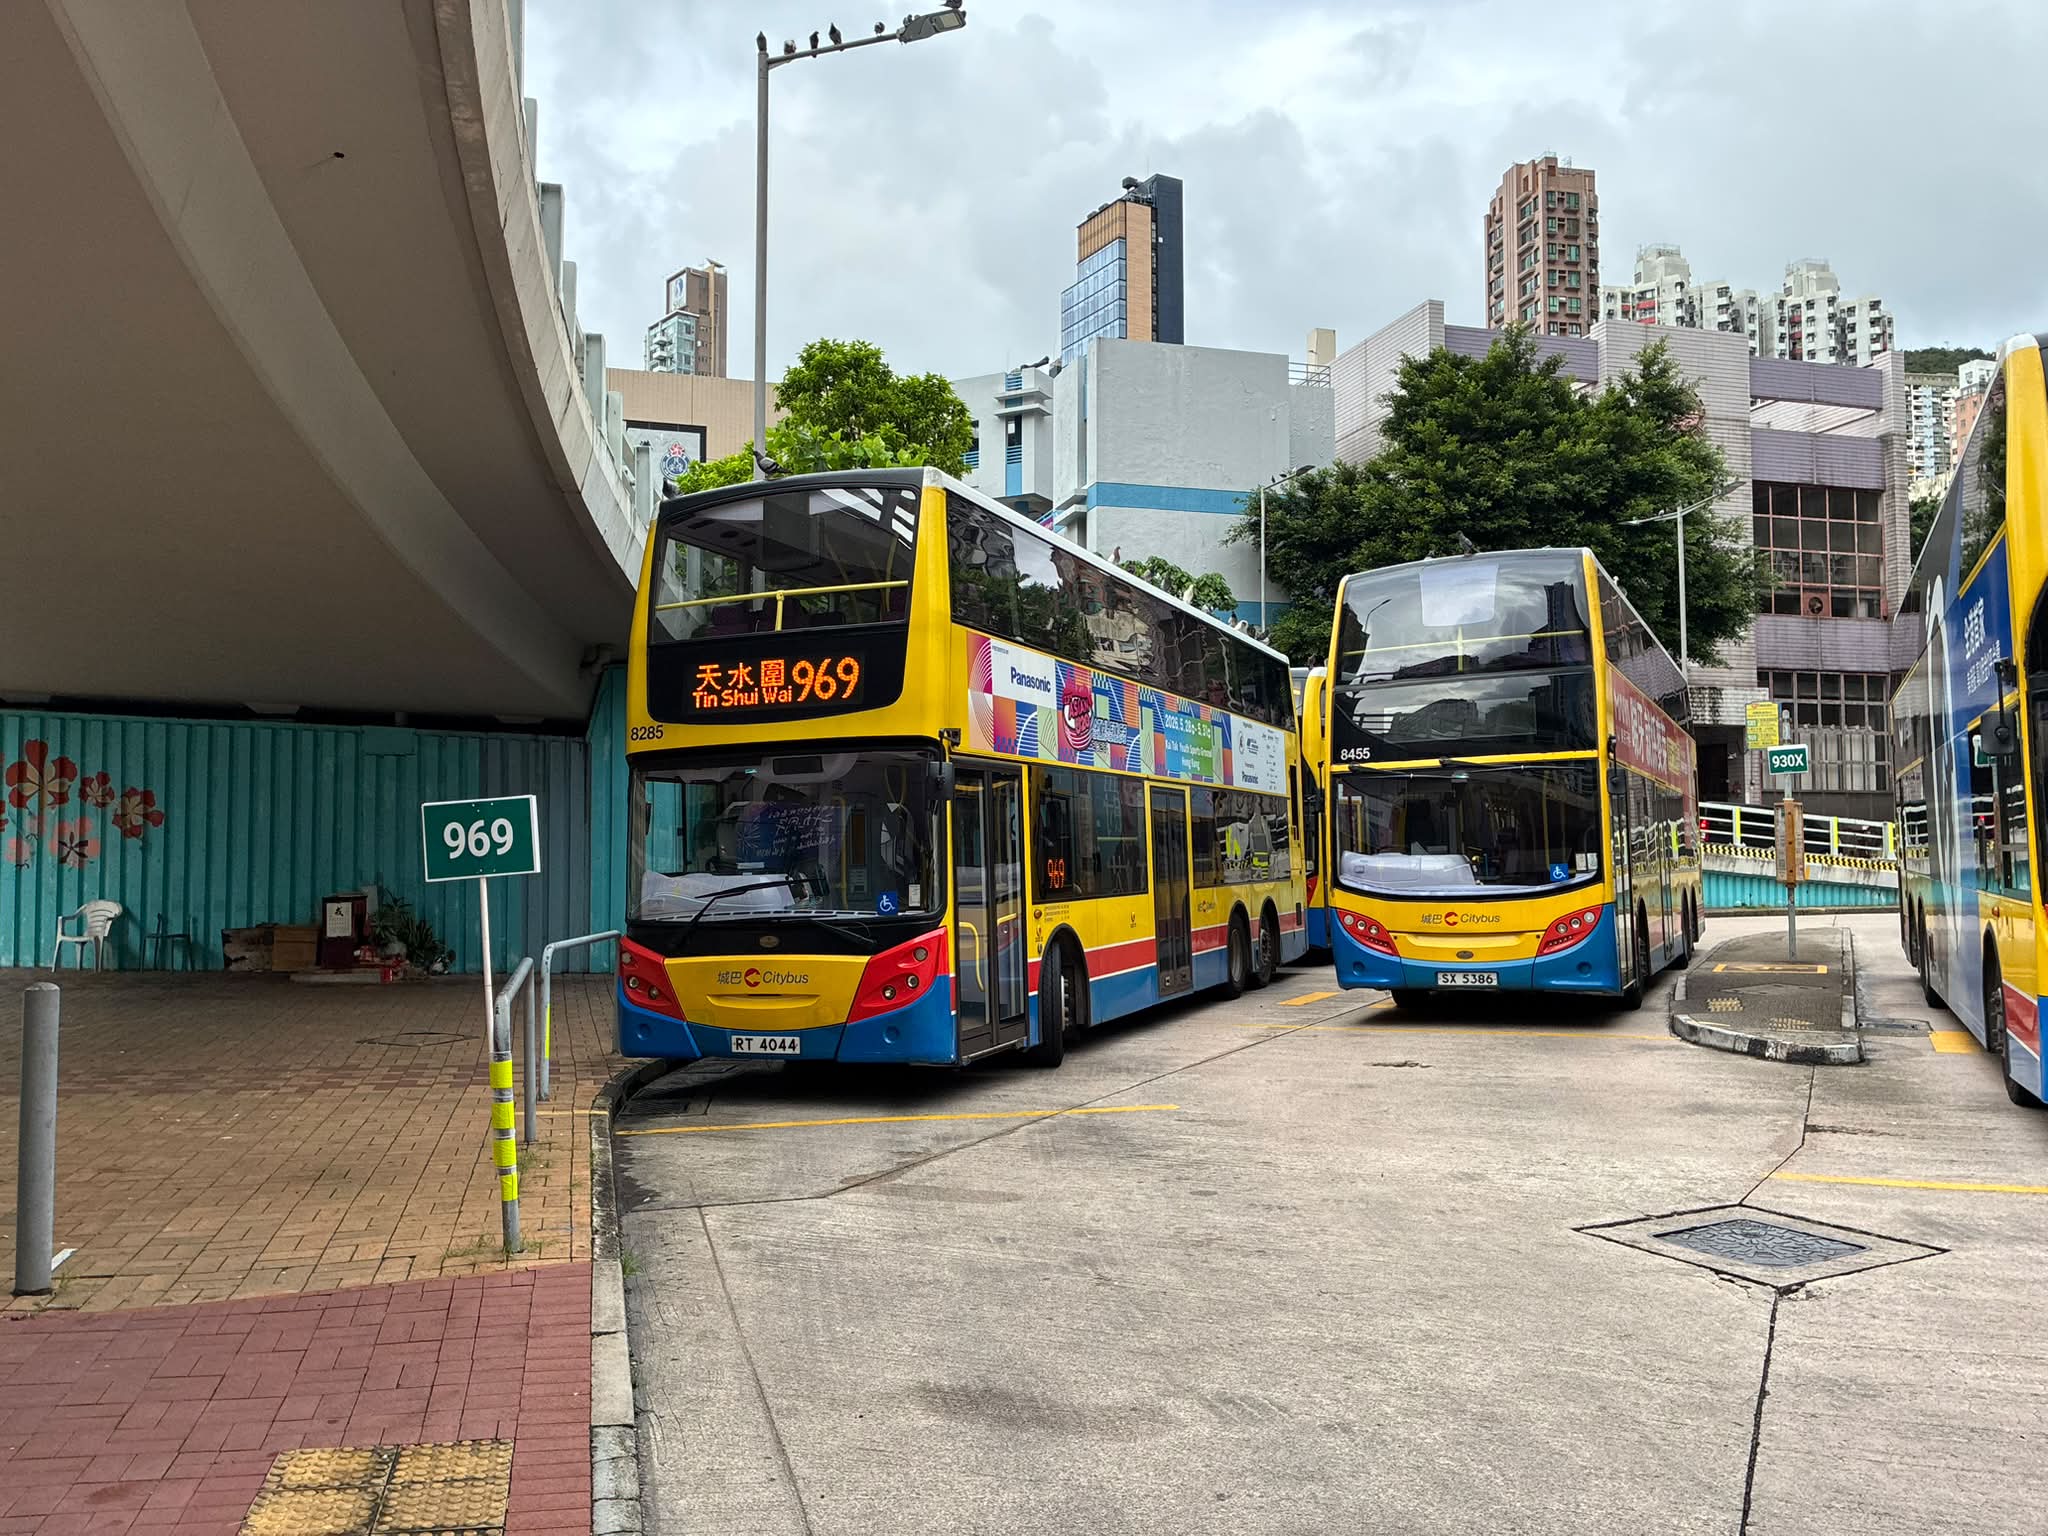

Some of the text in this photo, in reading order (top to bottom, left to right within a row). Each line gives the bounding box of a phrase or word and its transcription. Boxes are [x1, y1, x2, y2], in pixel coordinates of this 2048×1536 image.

[696, 659, 785, 690] 天水圍
[791, 656, 860, 702] 969
[1010, 665, 1051, 693] Panasonic
[692, 685, 792, 709] Tin Shui Wai
[630, 725, 664, 741] 8285
[1340, 748, 1371, 761] 8455
[1771, 753, 1805, 769] 930X
[442, 816, 515, 860] 969
[1047, 859, 1065, 889] 969
[1421, 913, 1443, 925] 城巴
[1459, 912, 1501, 925] Citybus
[717, 970, 742, 985] 城巴
[762, 970, 809, 985] Citybus
[1440, 972, 1494, 985] SX 5386
[734, 1037, 797, 1052] RT 4044
